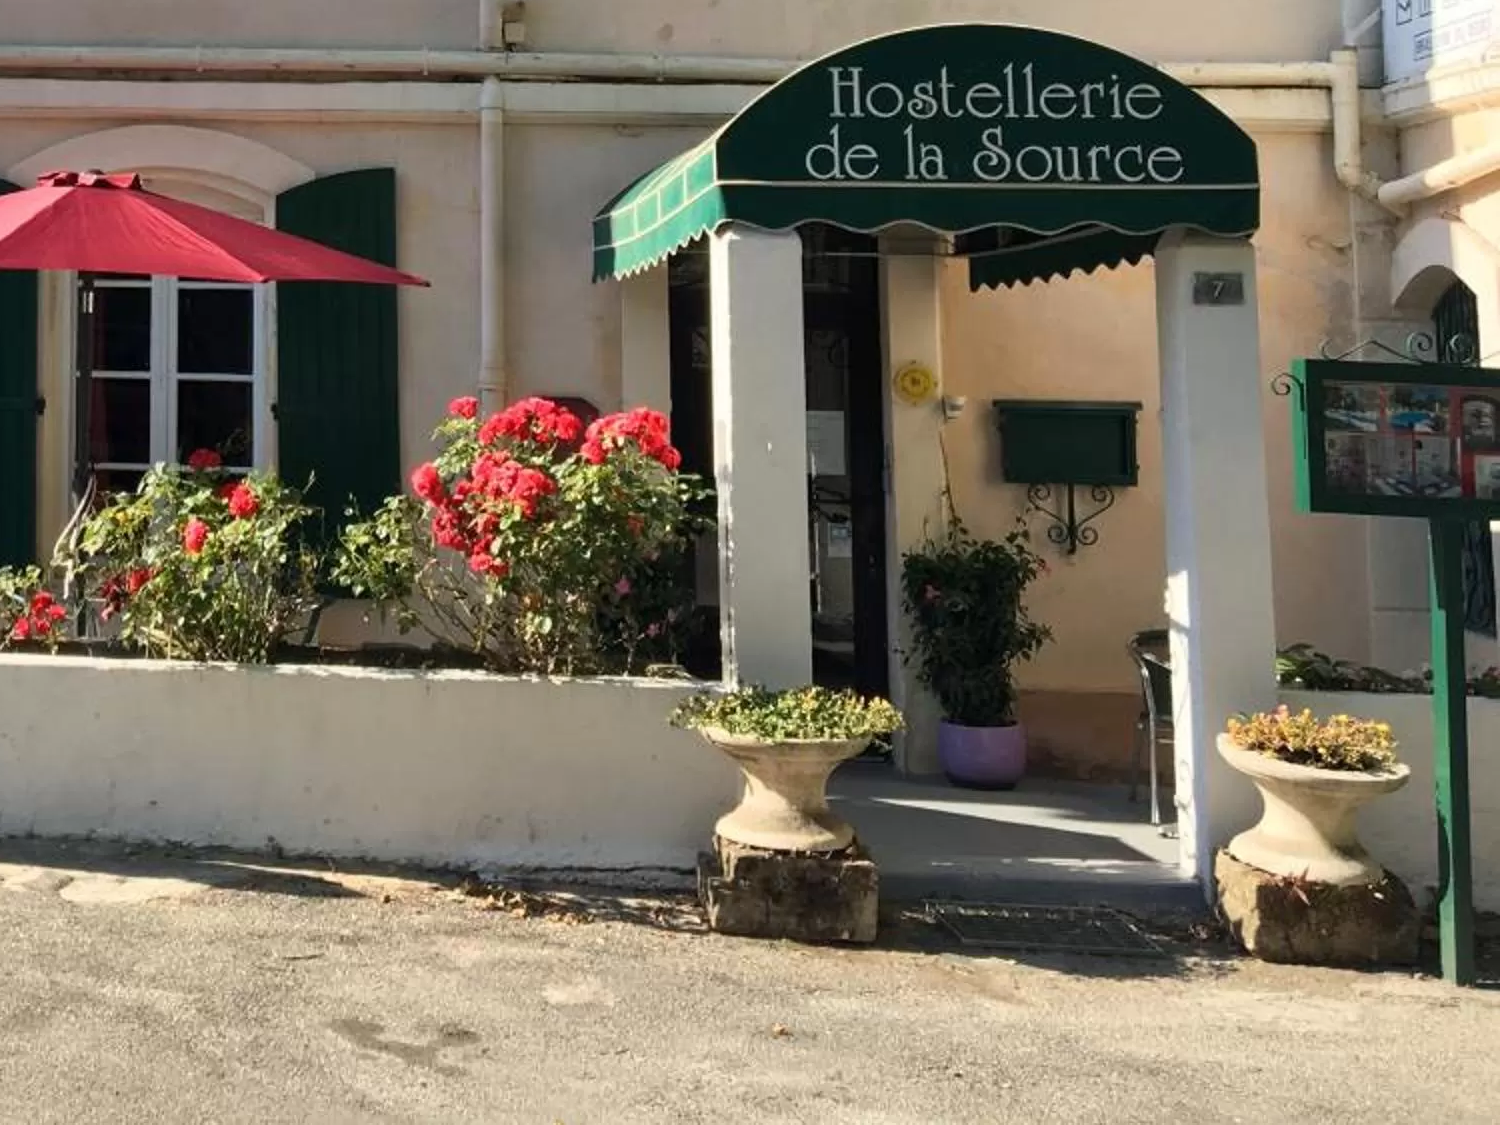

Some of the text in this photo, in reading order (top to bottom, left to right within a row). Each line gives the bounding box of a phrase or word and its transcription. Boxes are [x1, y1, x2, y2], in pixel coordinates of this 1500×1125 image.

[828, 63, 1163, 120] Hostellerie
[805, 124, 1185, 183] de la Source
